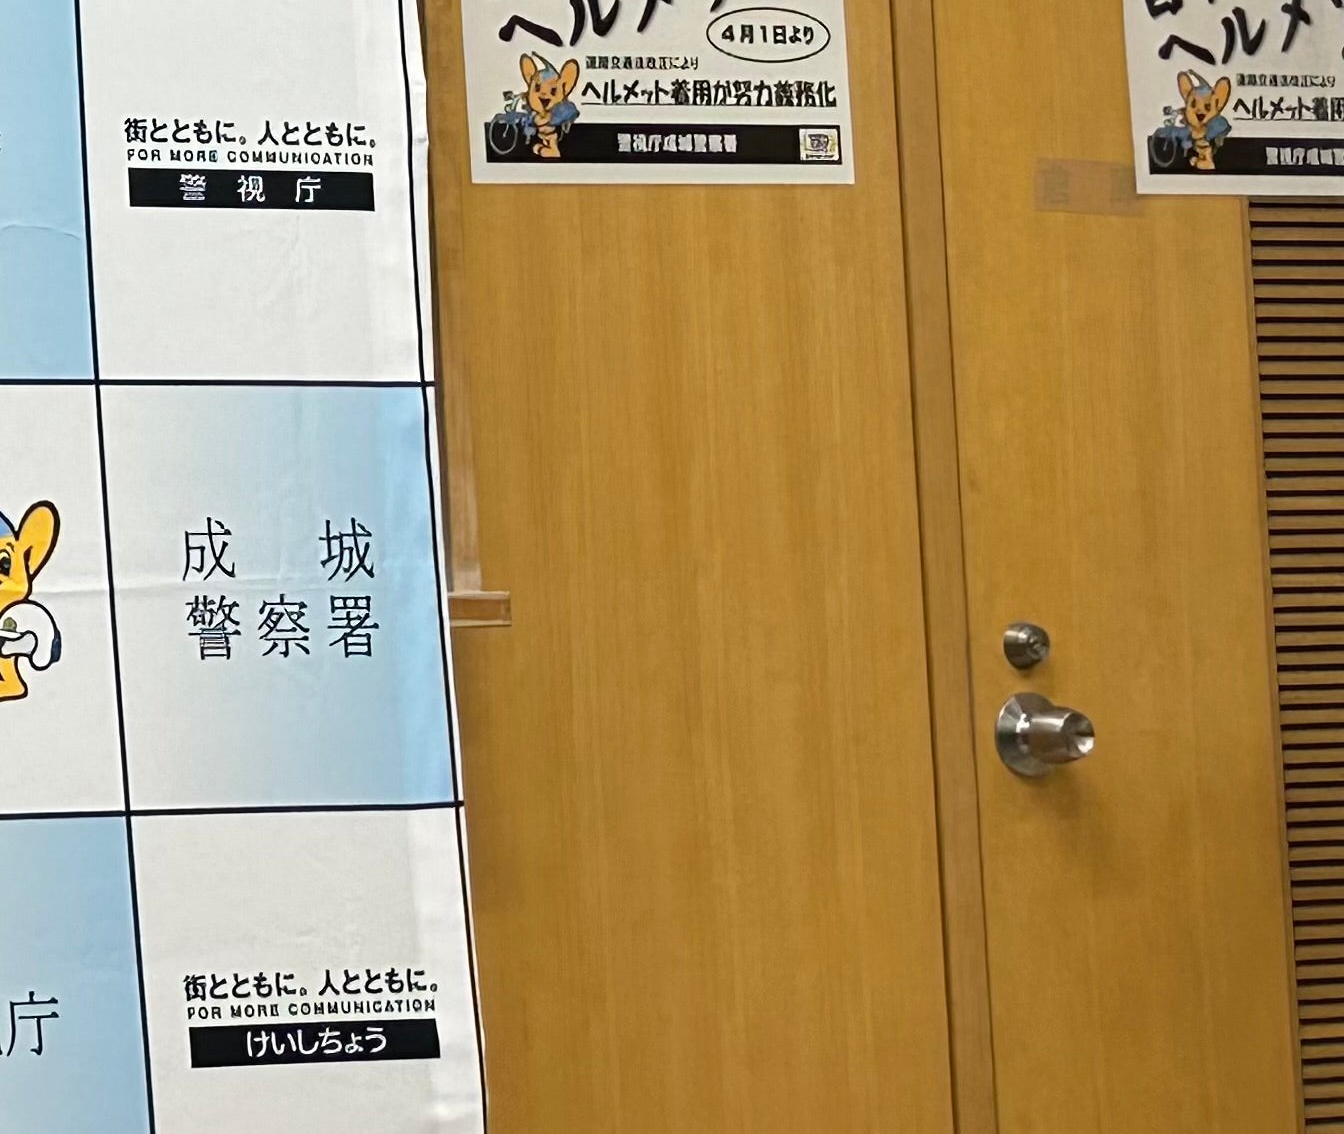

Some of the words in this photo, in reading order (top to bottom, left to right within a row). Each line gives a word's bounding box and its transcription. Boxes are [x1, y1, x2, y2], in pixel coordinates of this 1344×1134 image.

[721, 24, 814, 45] 4月1日より
[125, 118, 375, 148] 街とともに。人とともに。
[128, 149, 161, 161] FOR
[170, 150, 217, 162] MORE
[227, 151, 373, 165] COMMUNICATION
[180, 174, 321, 202] 警視庁
[185, 594, 379, 660] 警察署
[183, 968, 437, 1001] 街とともに。人とともに。
[188, 1007, 221, 1019] FOR
[231, 1004, 279, 1018] MORE
[288, 999, 435, 1016] COMMUNICATION
[247, 1027, 386, 1057] けいしちょう
